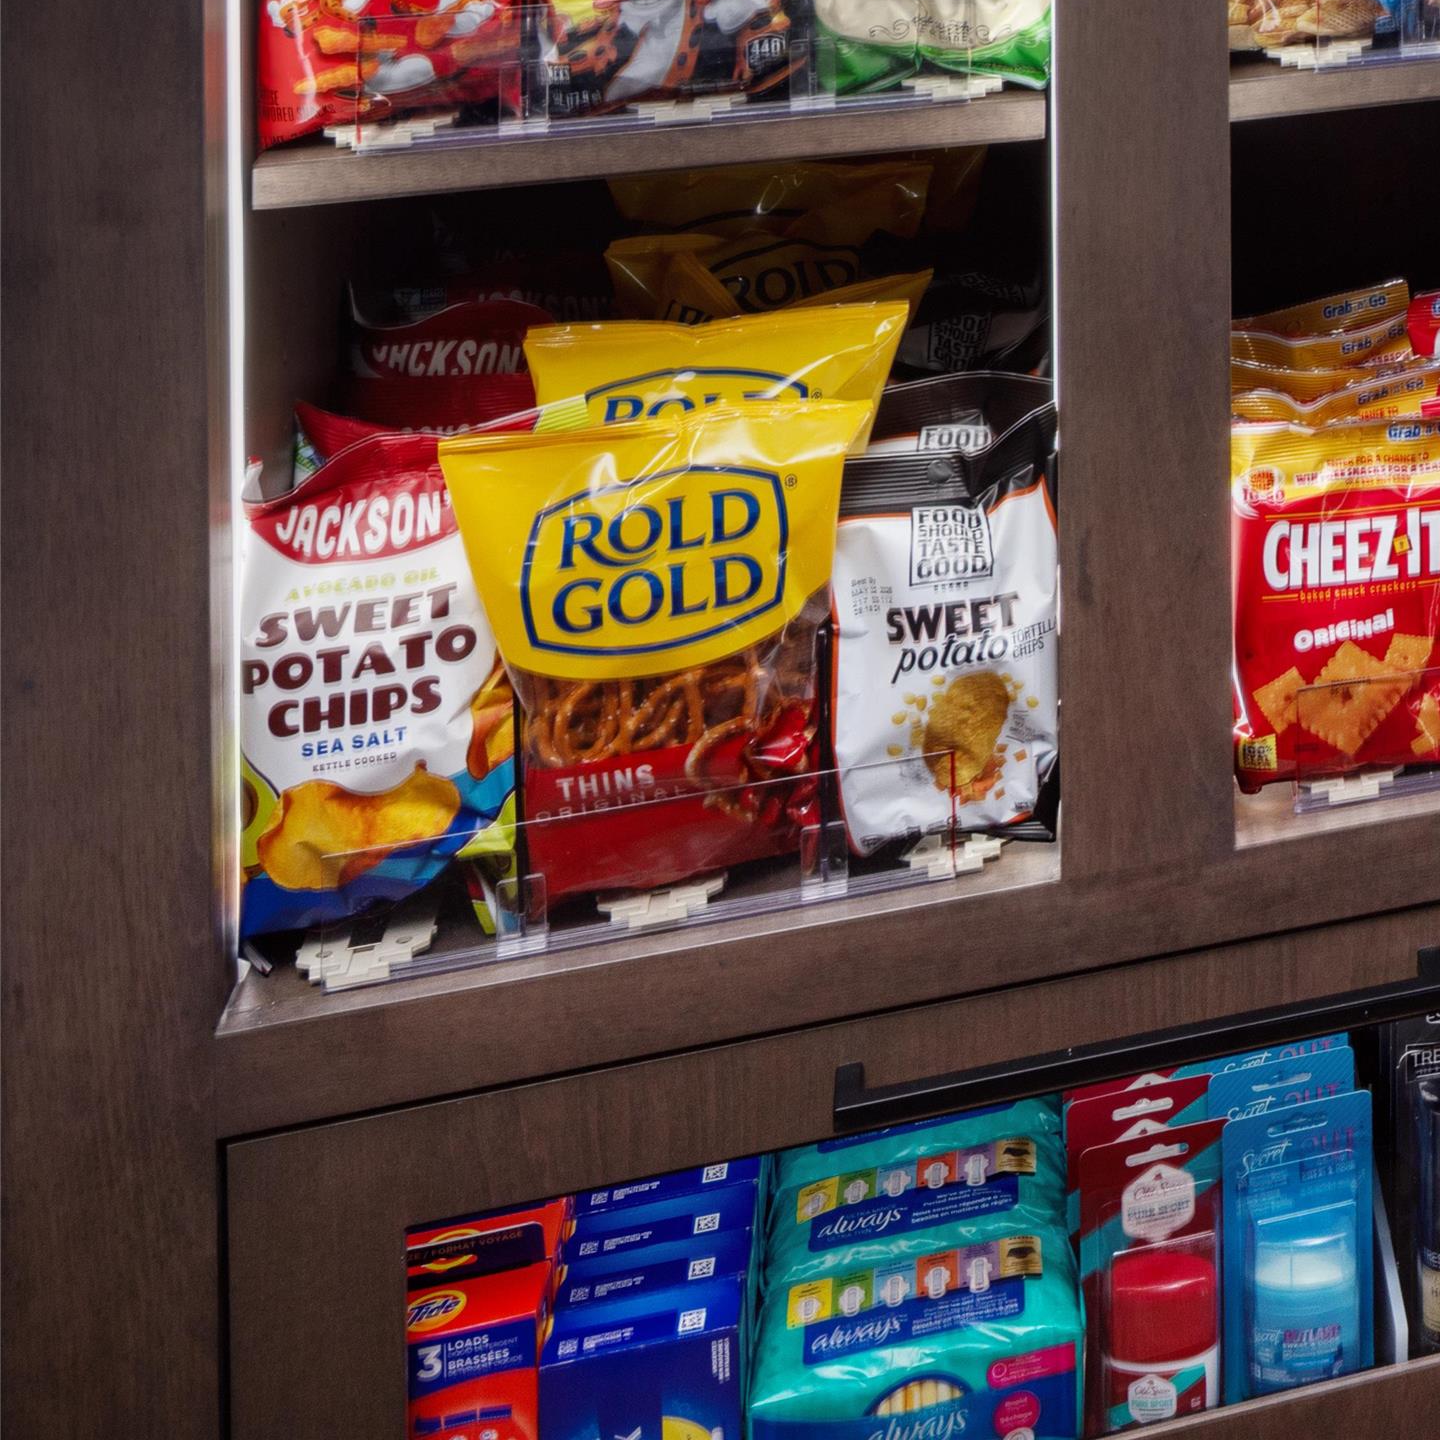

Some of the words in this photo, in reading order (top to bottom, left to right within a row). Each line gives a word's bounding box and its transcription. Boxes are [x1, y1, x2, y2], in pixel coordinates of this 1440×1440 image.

[560, 489, 760, 570] ROLD
[917, 508, 983, 529] FOOD
[917, 539, 985, 558] TASTE
[284, 570, 396, 604] AVOCADO
[404, 566, 440, 585] OIL
[553, 555, 762, 635] GOLD
[1299, 588, 1331, 604] baked
[1334, 585, 1366, 600] snack
[1368, 580, 1417, 597] crackers
[256, 583, 458, 649] SWEET
[887, 591, 1019, 645] SWEET
[243, 624, 477, 695] POTATO
[892, 628, 1010, 684] potato
[1012, 636, 1046, 659] CHIPS
[268, 675, 442, 738] CHIPS
[302, 740, 344, 758] SEA
[352, 726, 407, 750] SALT
[312, 758, 351, 773] KETTLE
[354, 751, 397, 767] COOKED
[536, 783, 687, 823] ORIGINAL
[555, 765, 655, 805] THINS
[1241, 1138, 1293, 1178] Secret
[818, 1208, 902, 1239] always
[431, 1243, 475, 1257] FORMAT
[479, 1231, 523, 1247] VOYAGE
[407, 1297, 462, 1329] Tide
[447, 1334, 490, 1352] LOADS
[811, 1316, 901, 1355] always
[417, 1343, 443, 1381] 3
